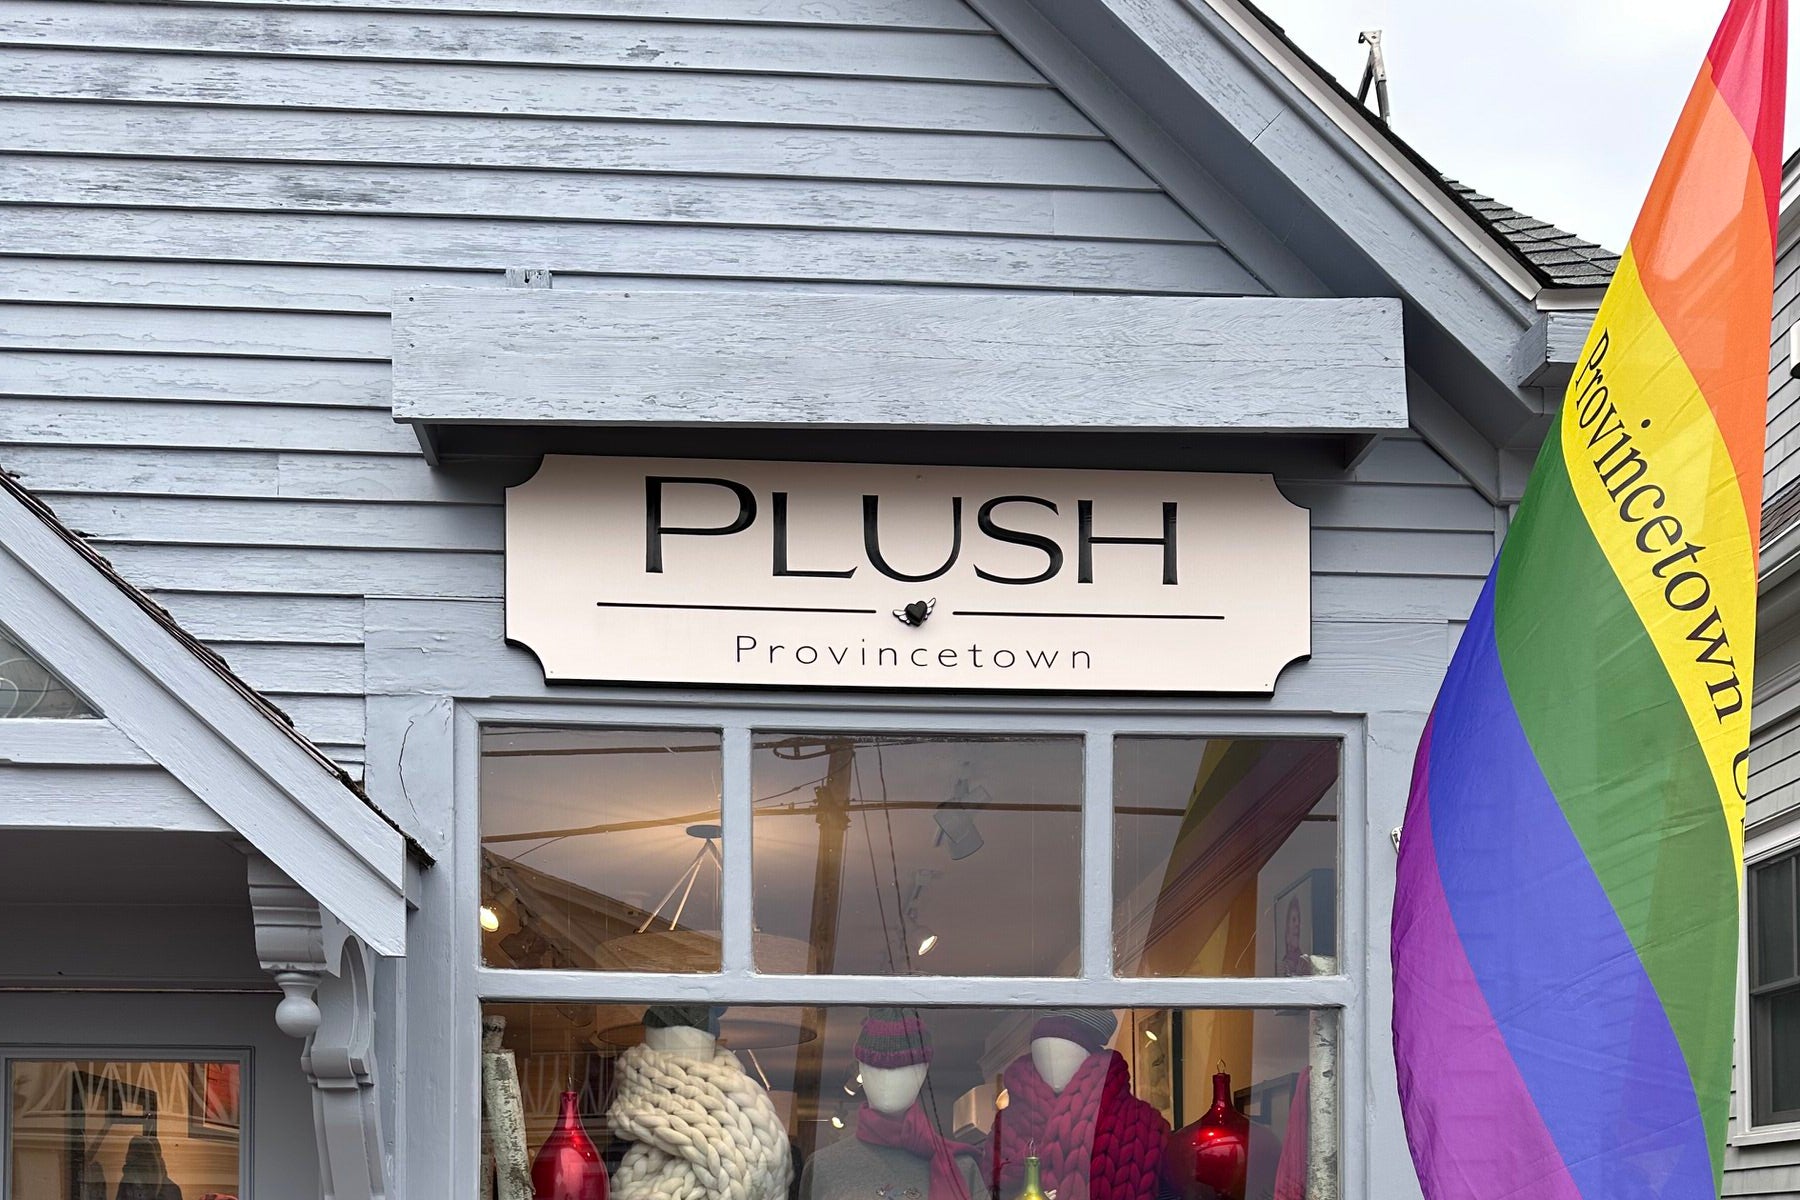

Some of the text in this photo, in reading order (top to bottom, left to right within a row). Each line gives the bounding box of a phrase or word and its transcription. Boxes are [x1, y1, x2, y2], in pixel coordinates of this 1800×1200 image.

[644, 475, 1179, 586] PLUSH
[1574, 328, 1743, 724] Provincetown
[736, 635, 1092, 671] Provincetown
